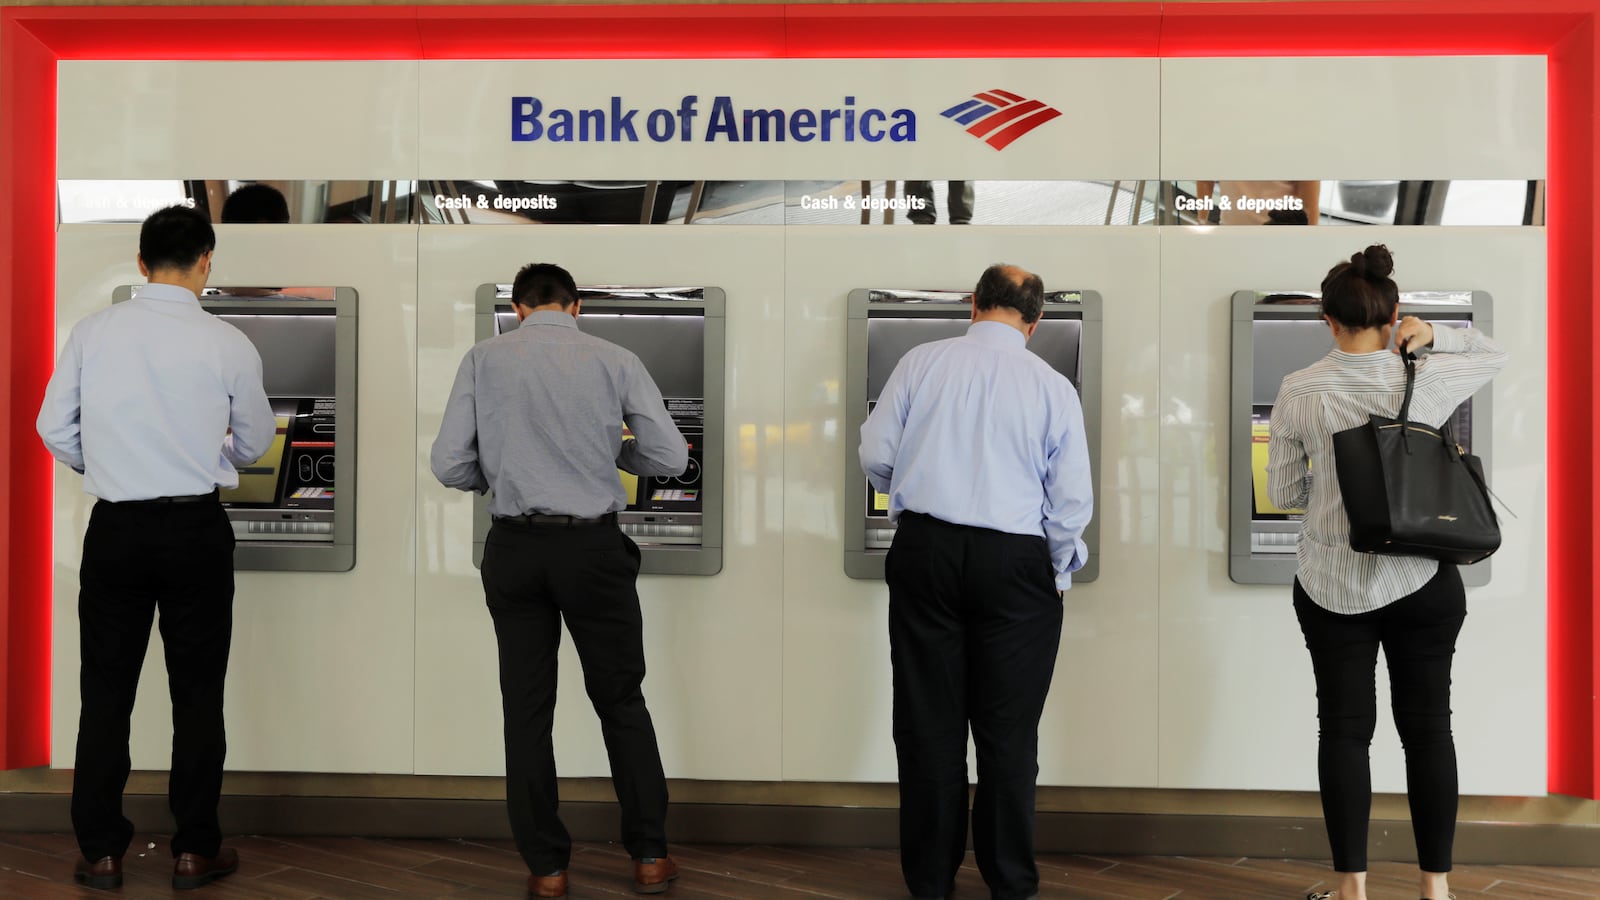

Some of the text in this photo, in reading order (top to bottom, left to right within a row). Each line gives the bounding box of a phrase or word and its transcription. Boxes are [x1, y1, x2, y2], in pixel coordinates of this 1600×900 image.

[511, 95, 917, 142] Bank of America
[434, 194, 558, 212] Cash & deposits
[800, 194, 926, 213] Cash & deposits
[1175, 195, 1304, 213] Cash & deposits
